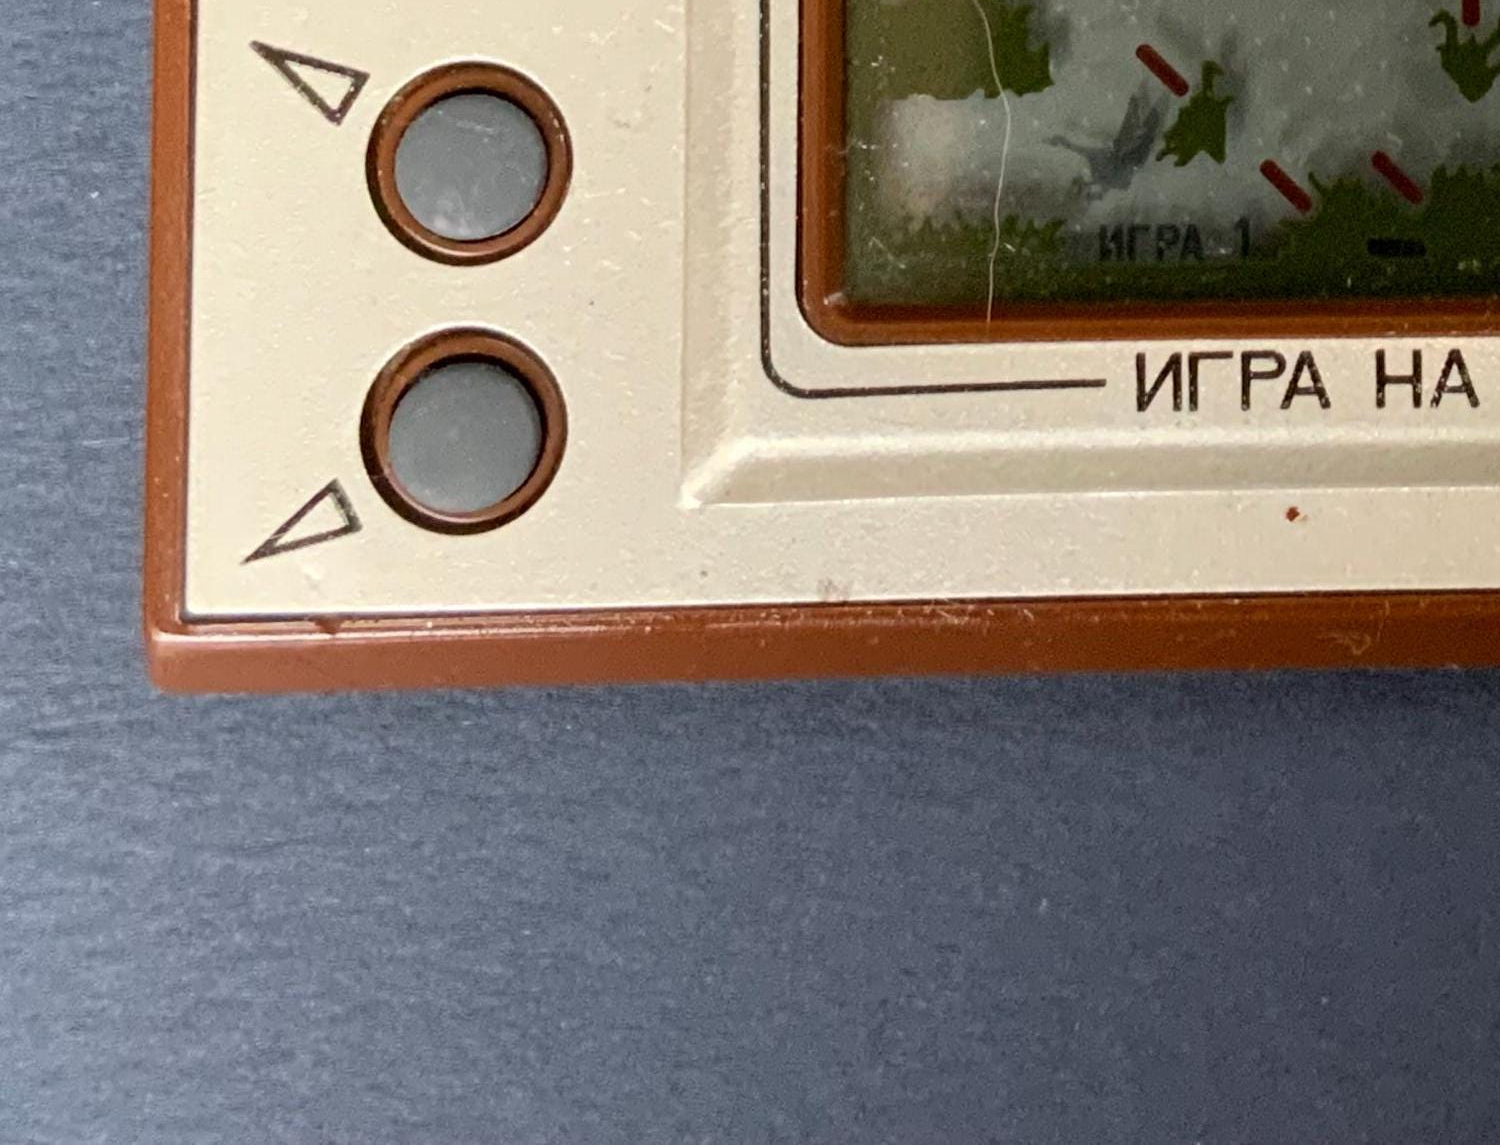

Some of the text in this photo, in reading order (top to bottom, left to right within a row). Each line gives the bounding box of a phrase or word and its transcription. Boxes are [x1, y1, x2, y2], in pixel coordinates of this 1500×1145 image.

[1100, 223, 1204, 261] ИГРА
[1136, 349, 1331, 412] ИГРА
[1375, 348, 1480, 409] НА
